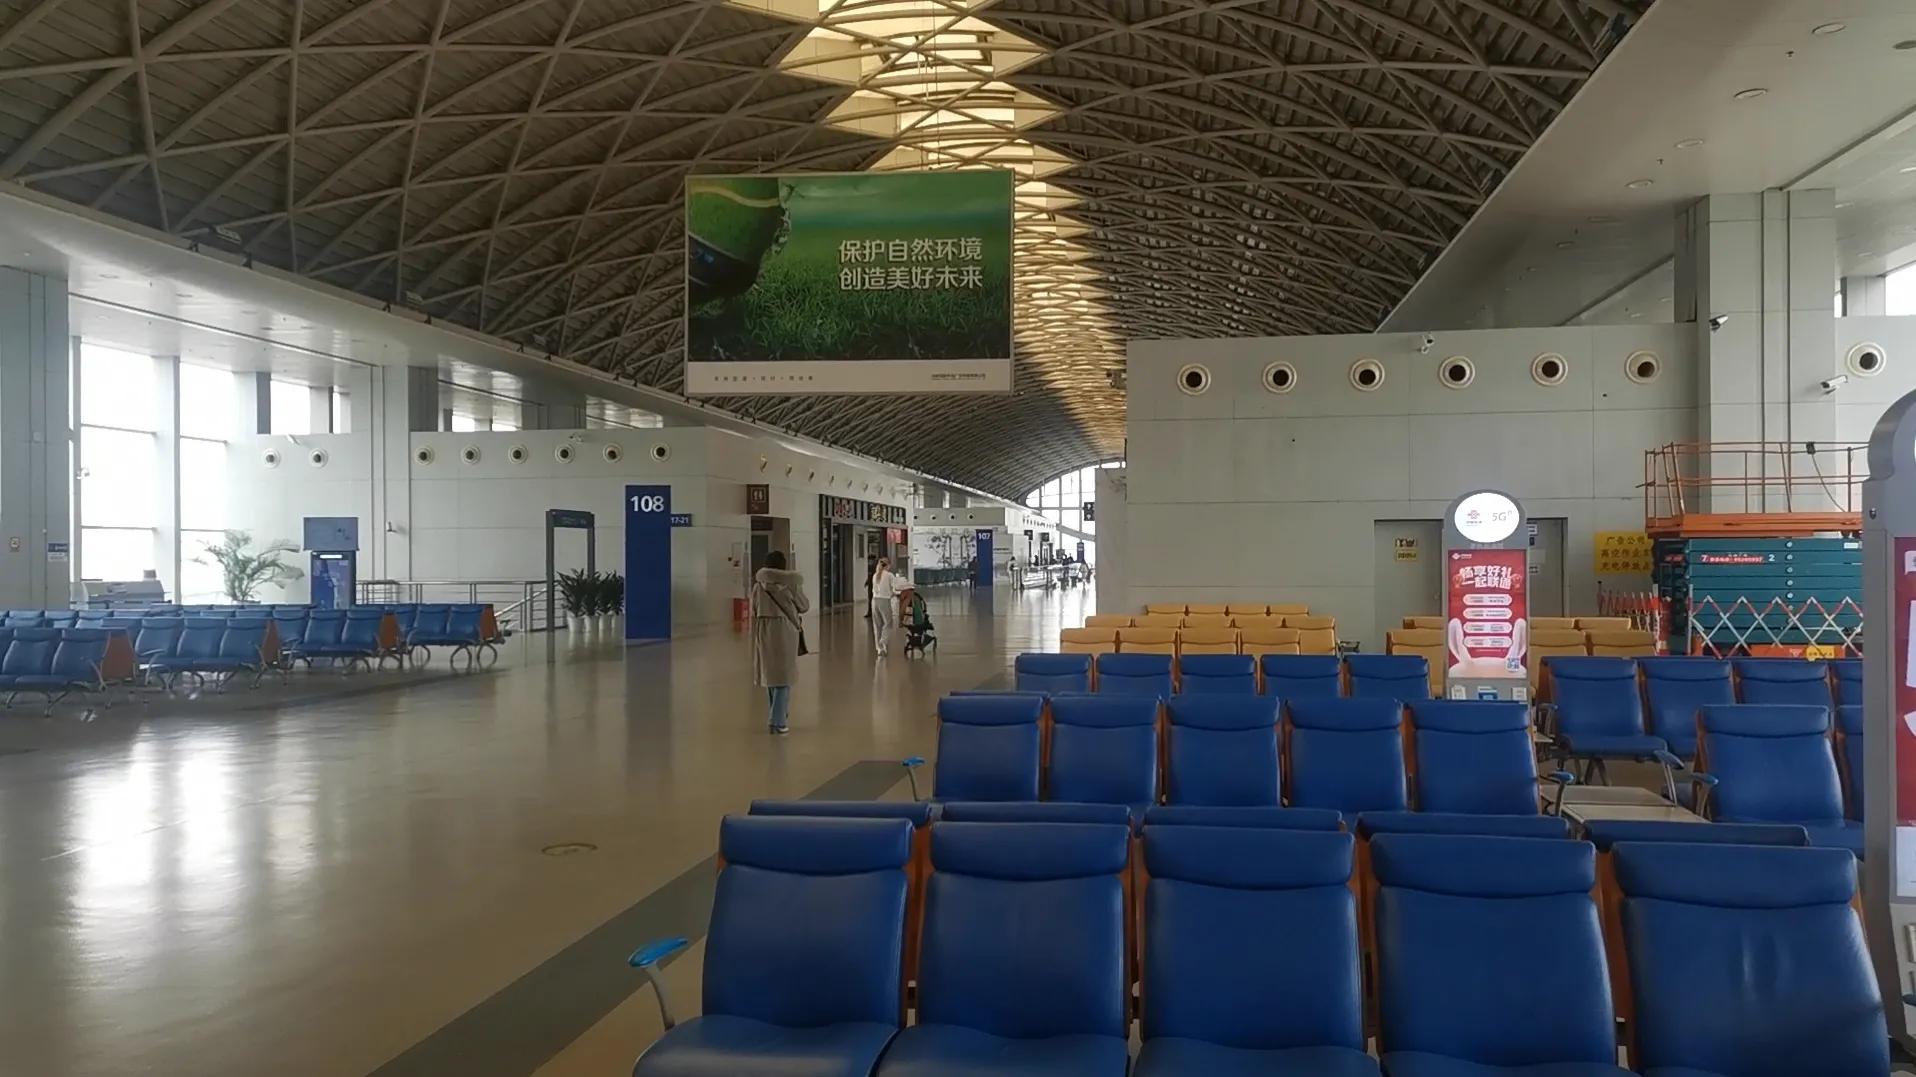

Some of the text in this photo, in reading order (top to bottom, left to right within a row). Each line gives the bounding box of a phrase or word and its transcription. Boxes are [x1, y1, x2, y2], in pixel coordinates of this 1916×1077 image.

[838, 237, 983, 264] 保护自然环境
[838, 265, 984, 291] 创造美好未来
[630, 495, 664, 512] 108
